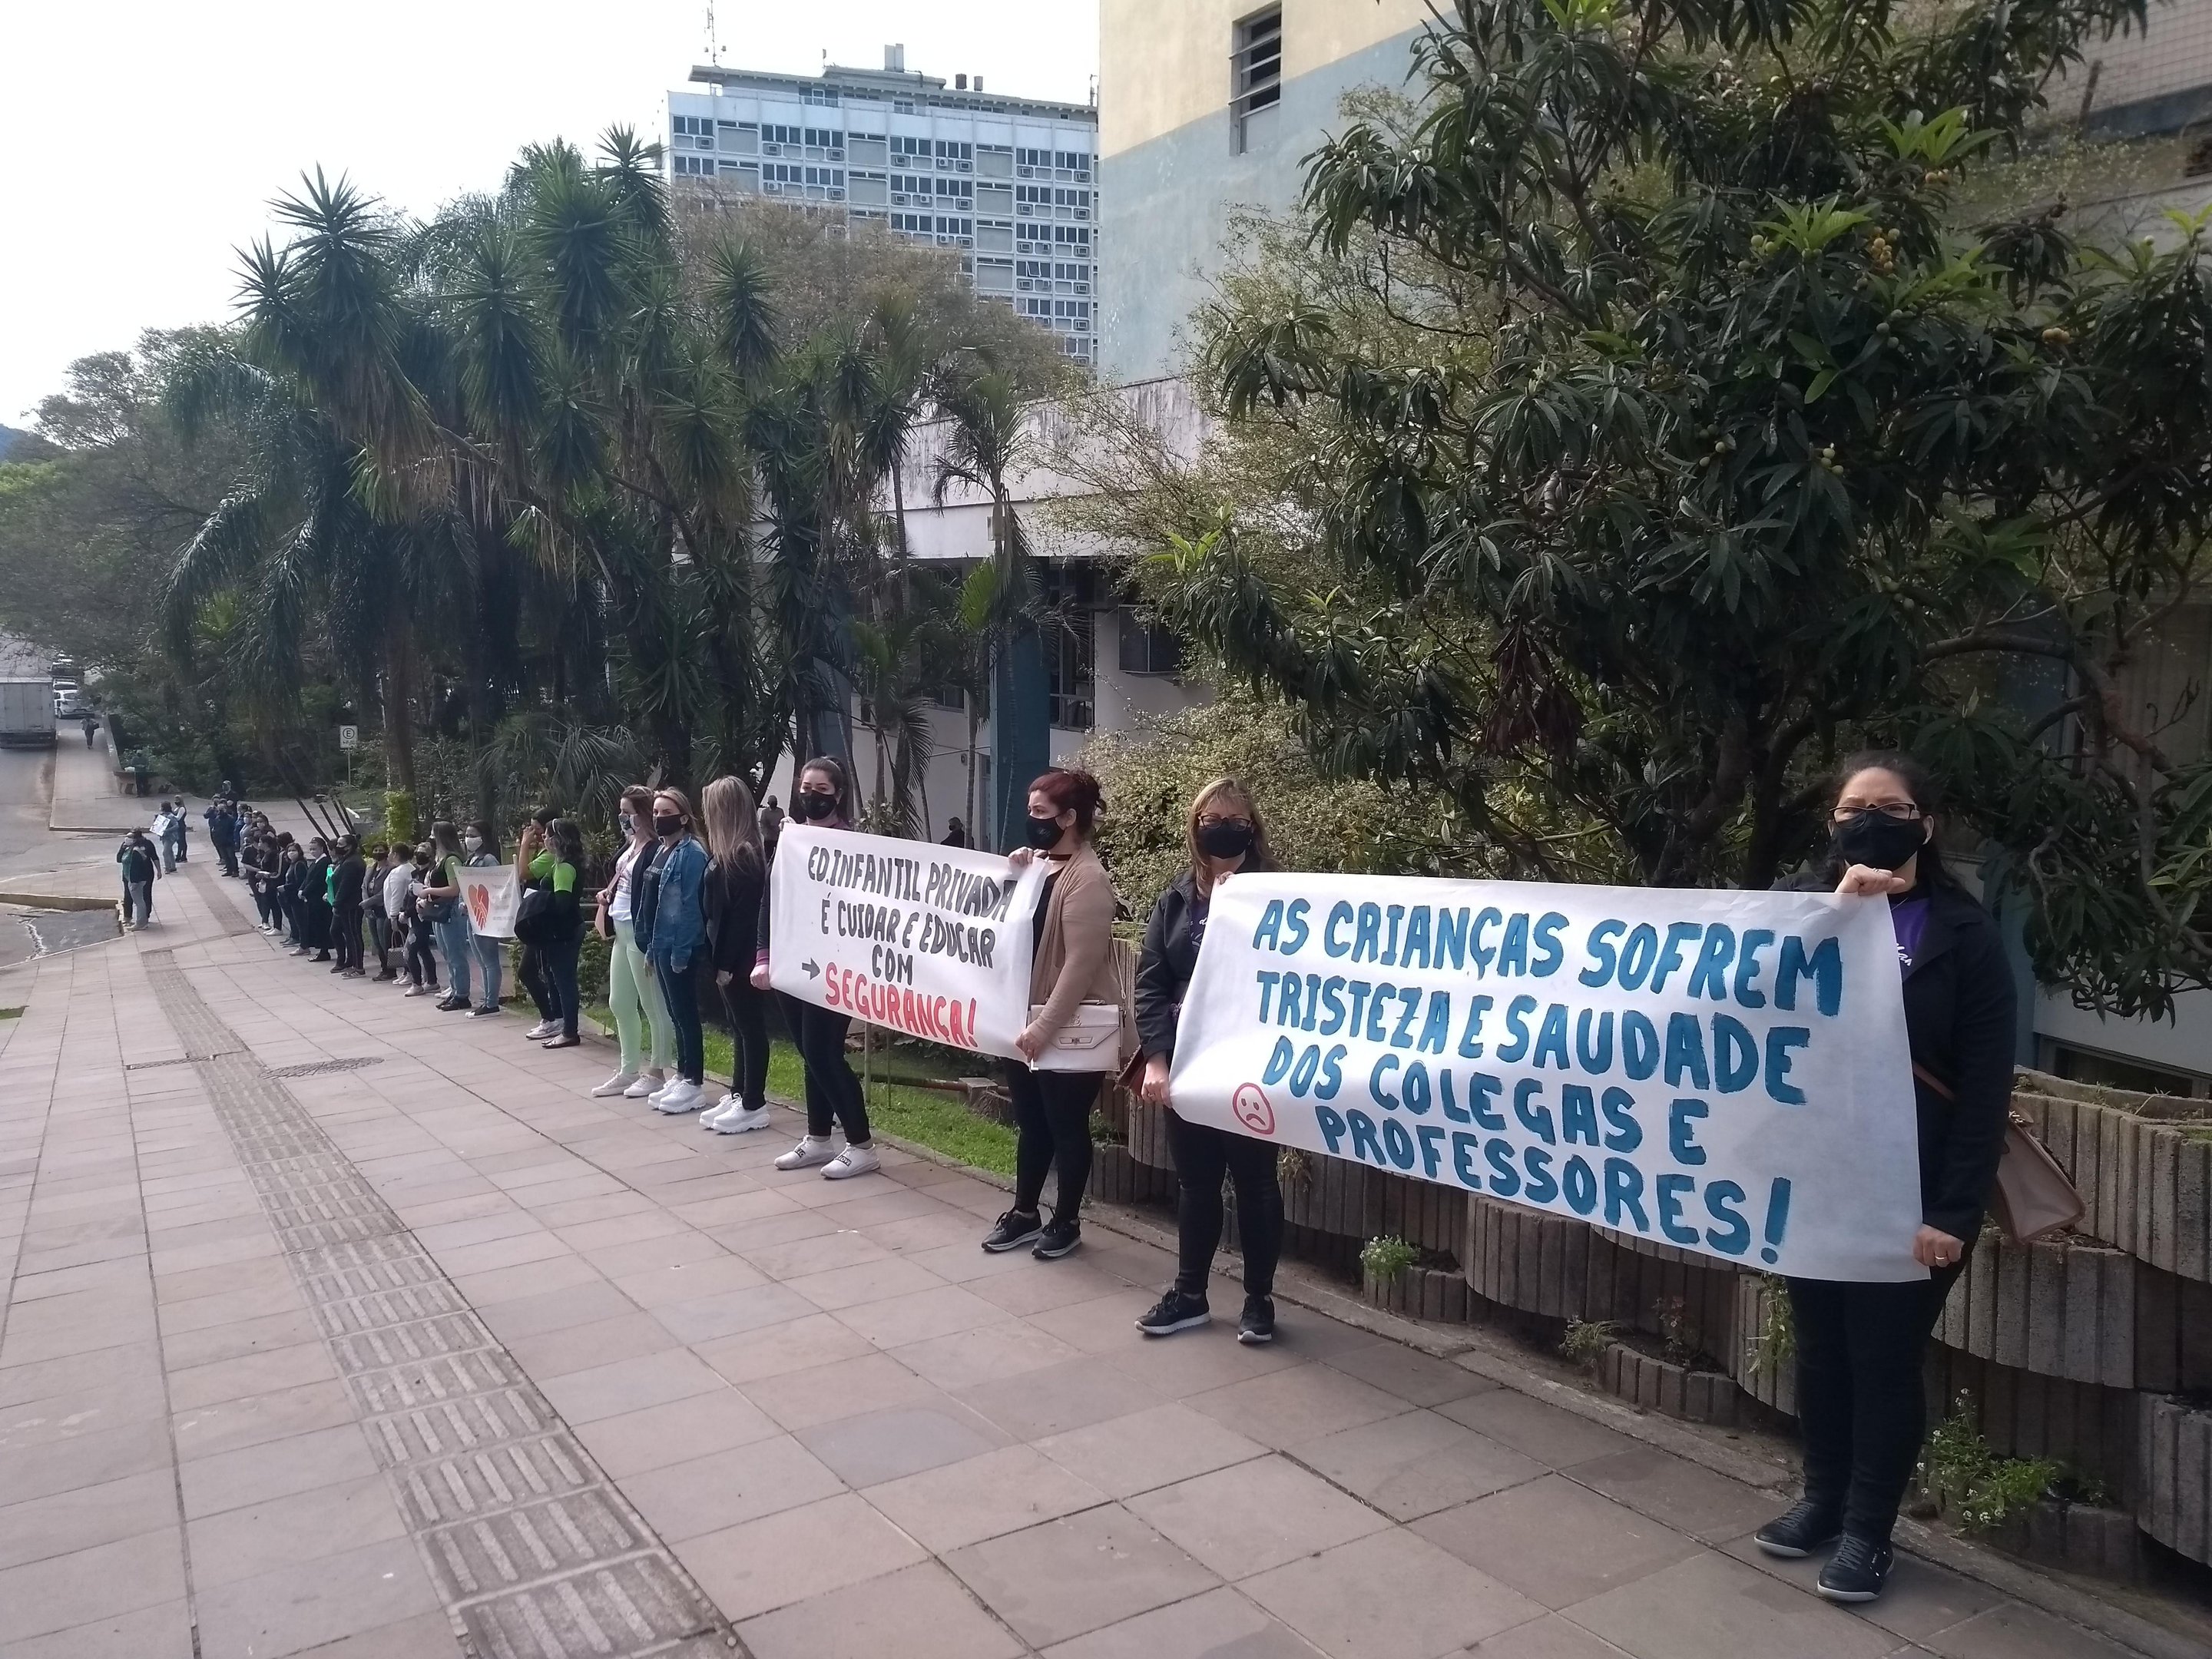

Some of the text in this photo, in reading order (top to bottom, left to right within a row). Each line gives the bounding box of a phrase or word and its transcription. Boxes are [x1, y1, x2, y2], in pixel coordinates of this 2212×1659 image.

[821, 892, 996, 969] É CUIDAR E EDUCAR
[925, 862, 1018, 922] PRIVADA
[826, 962, 979, 1048] SEGURANÇA!
[872, 944, 913, 987] COM
[1253, 898, 1843, 1017] AS CRIANÇAS SOFREM
[1257, 970, 1811, 1105] TRISTEZA E SAUDADE
[1262, 1035, 1709, 1165] DOS COLEGAS E
[1314, 1105, 1791, 1265] PROFESSORES!
